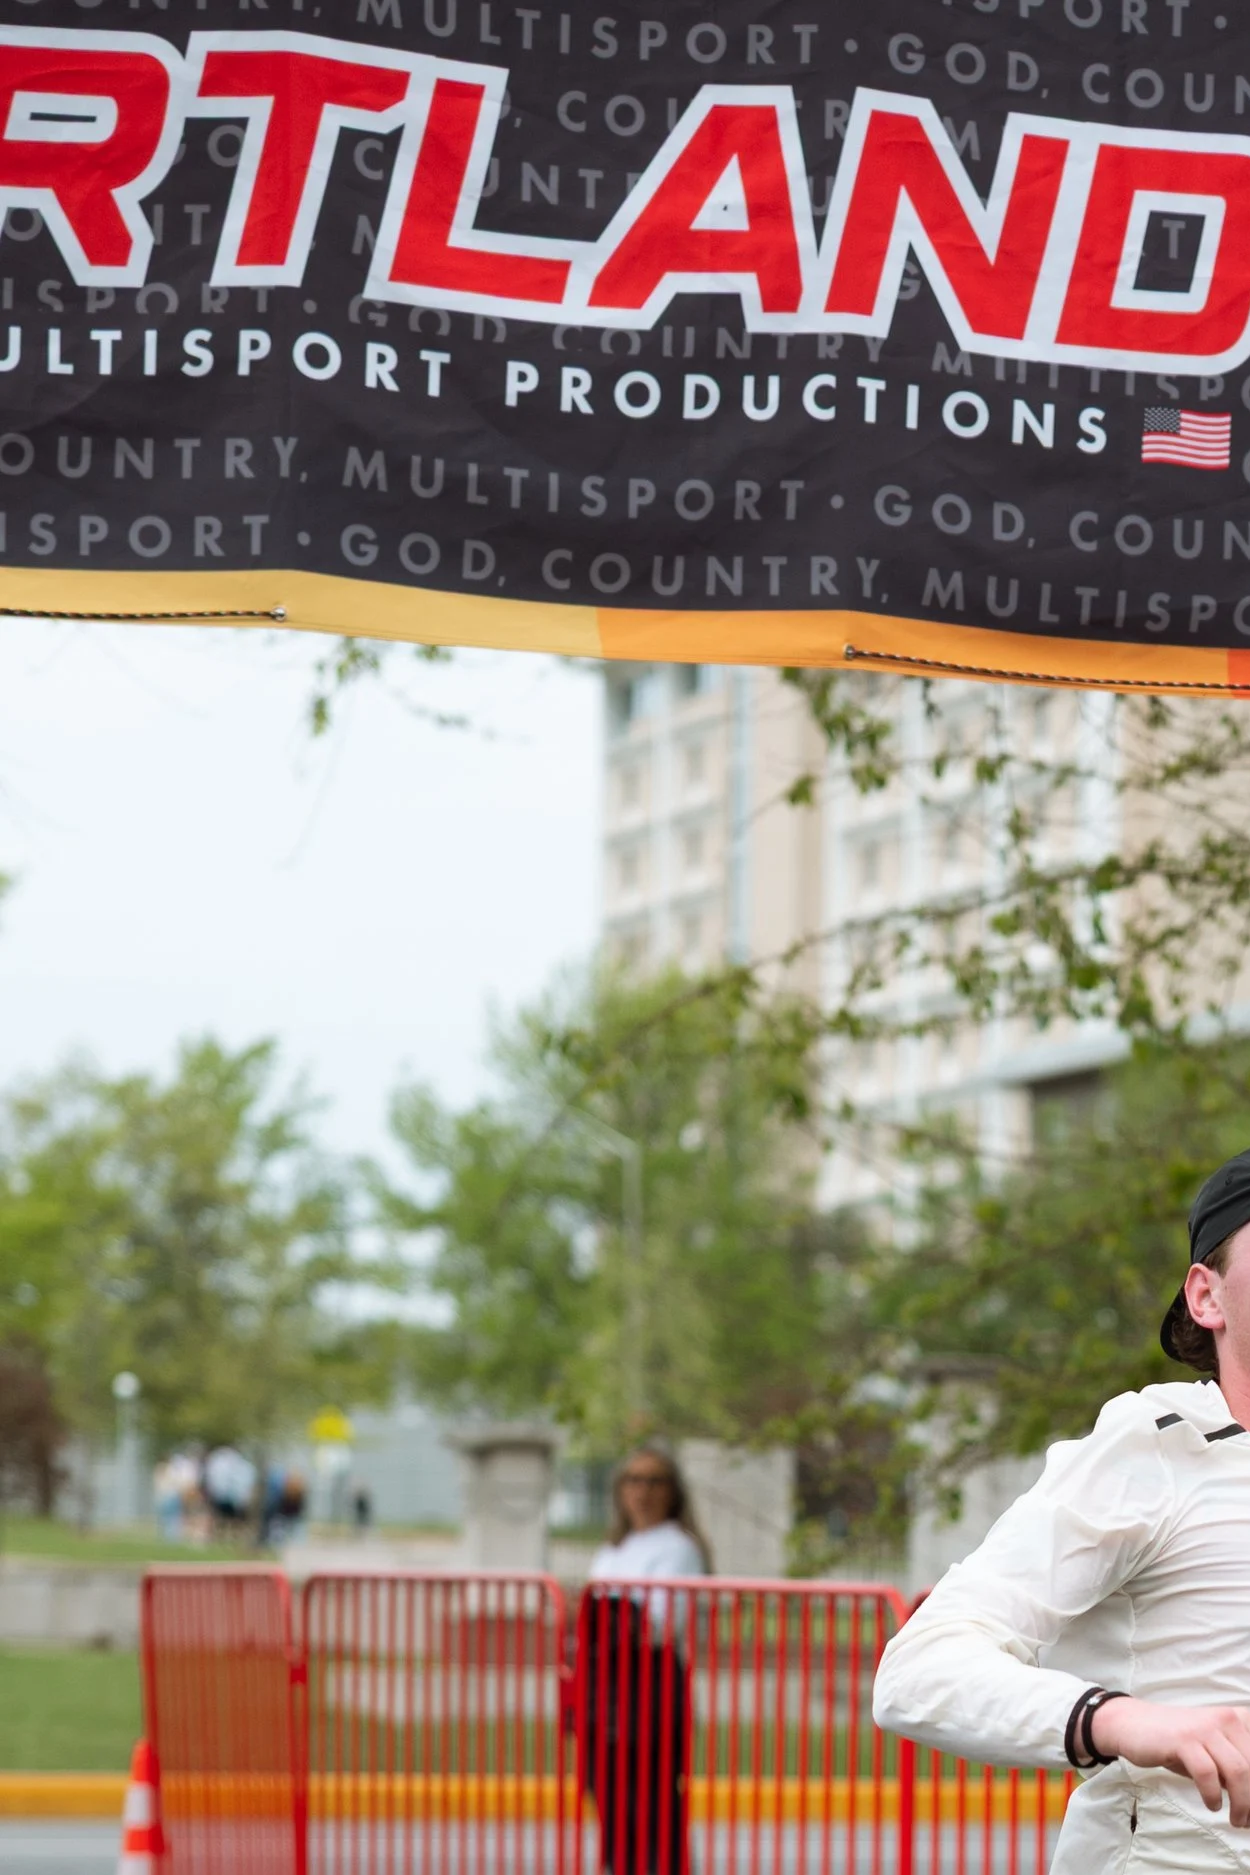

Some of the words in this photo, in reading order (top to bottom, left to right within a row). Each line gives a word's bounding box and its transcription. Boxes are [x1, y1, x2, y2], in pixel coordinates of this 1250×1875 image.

[888, 33, 1048, 98] GOD,
[505, 360, 1108, 455] PRODUCTIONS
[342, 446, 804, 521] MULTISPORT
[874, 485, 1034, 548] GOD,
[340, 524, 506, 588] GOD,
[541, 548, 888, 604] COUNTRY,
